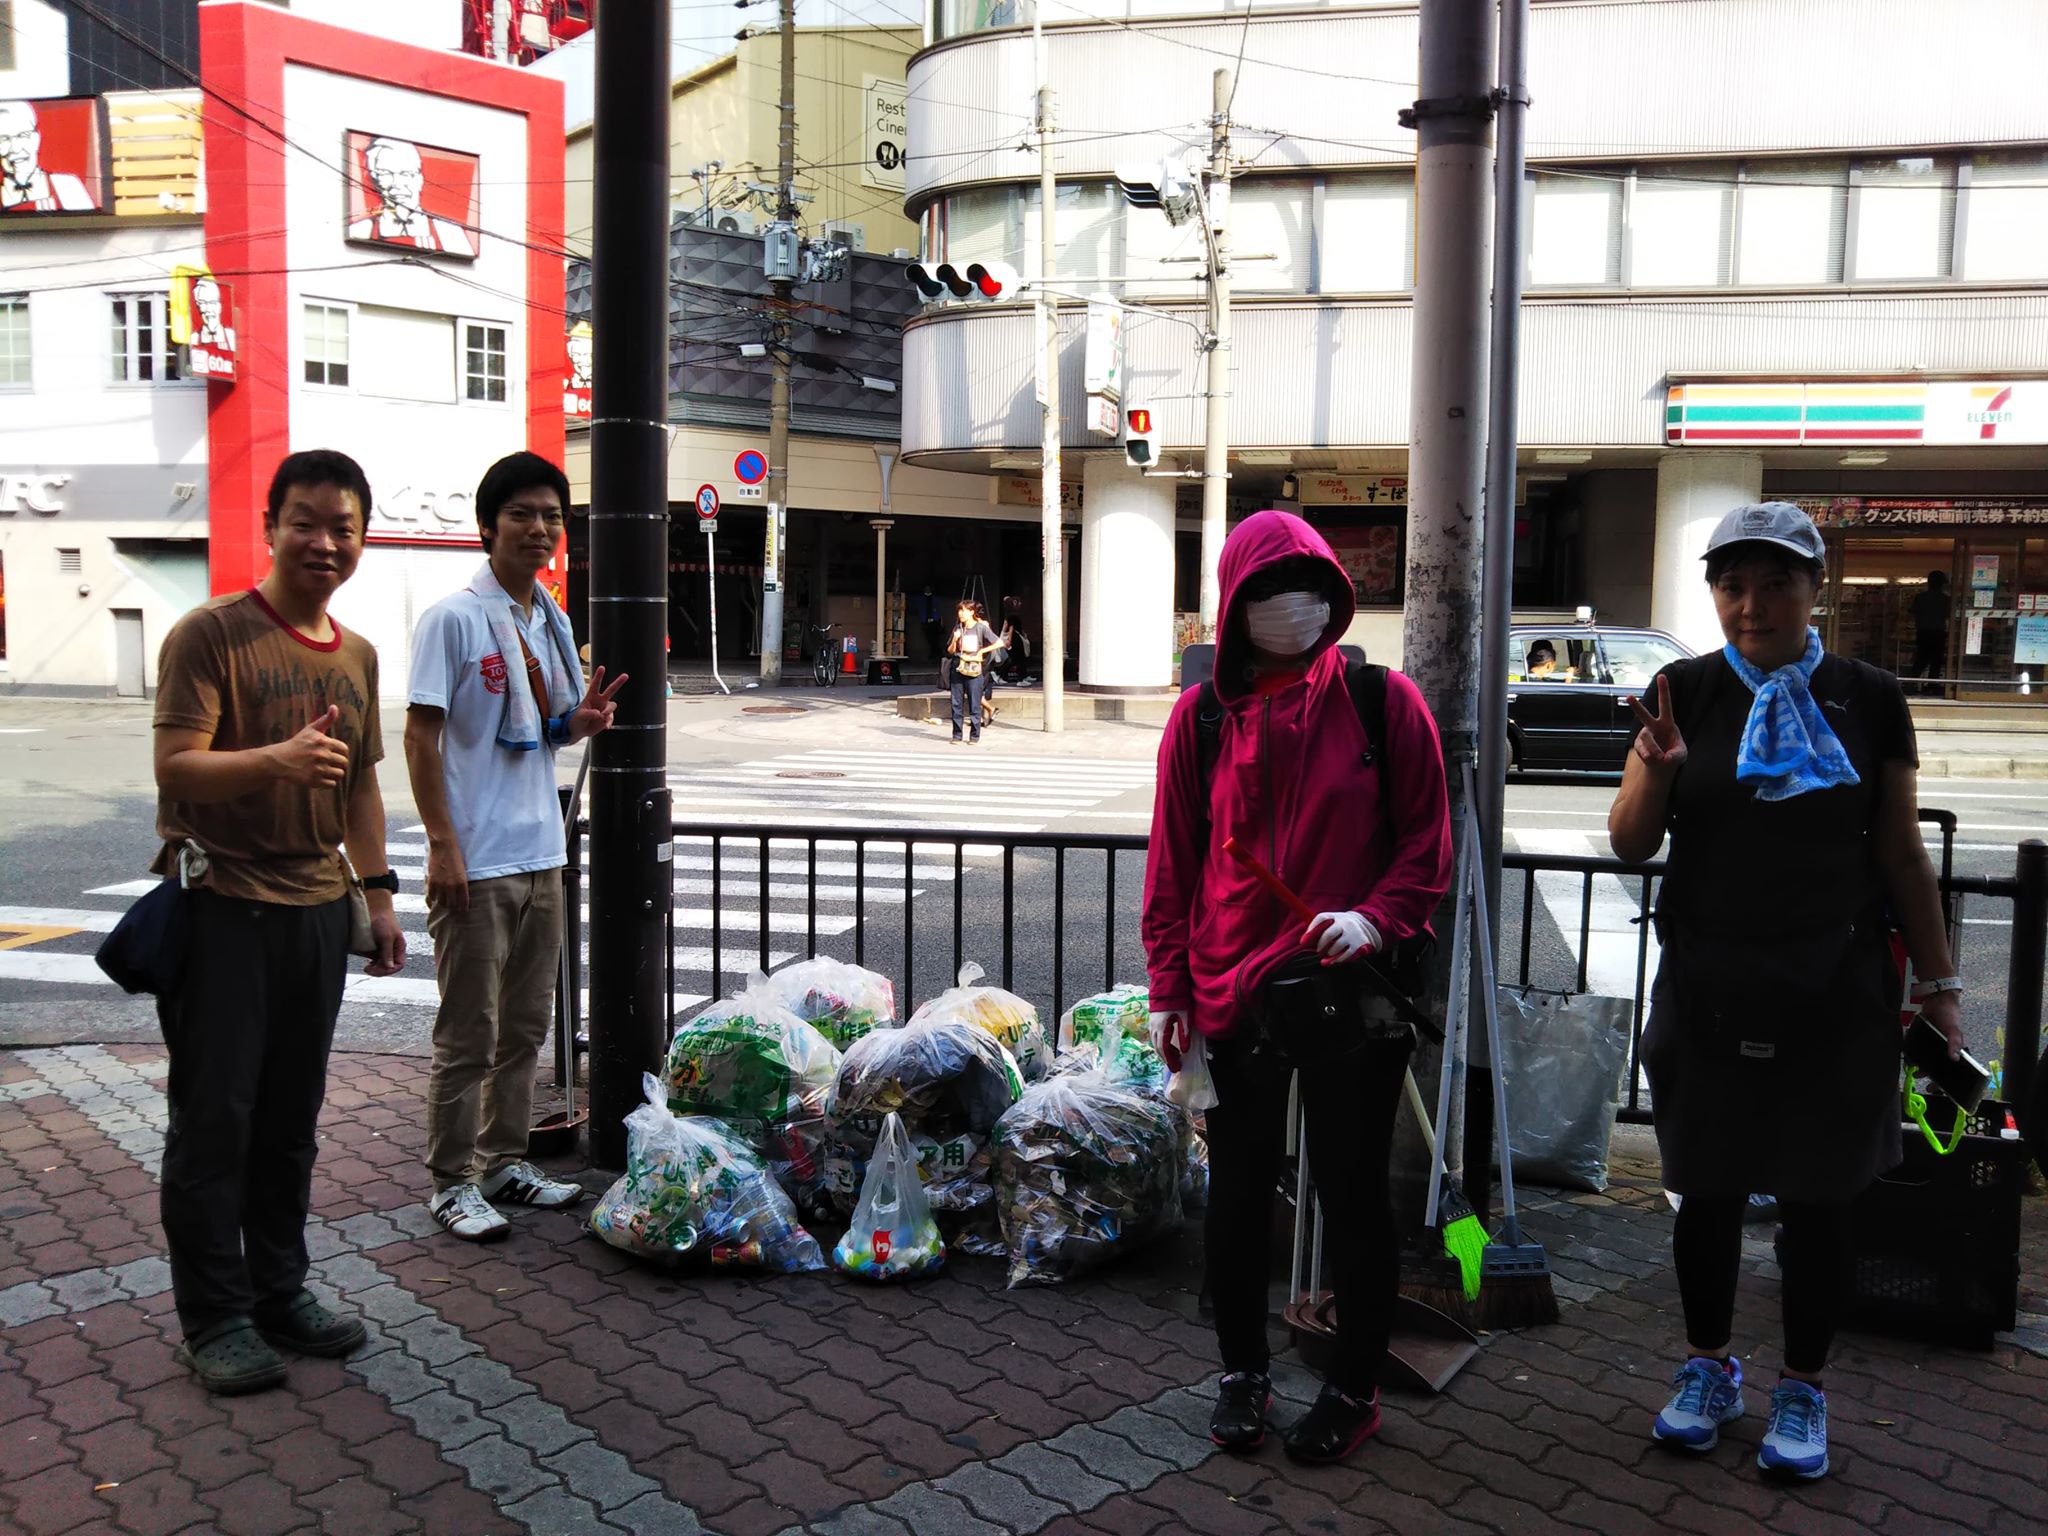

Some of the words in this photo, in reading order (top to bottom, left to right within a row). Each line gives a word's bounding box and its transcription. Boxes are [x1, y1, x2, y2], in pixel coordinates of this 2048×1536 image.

[876, 118, 906, 136] Cine
[1970, 385, 2013, 440] 7
[0, 474, 72, 512] FC
[739, 488, 761, 496] 自動車
